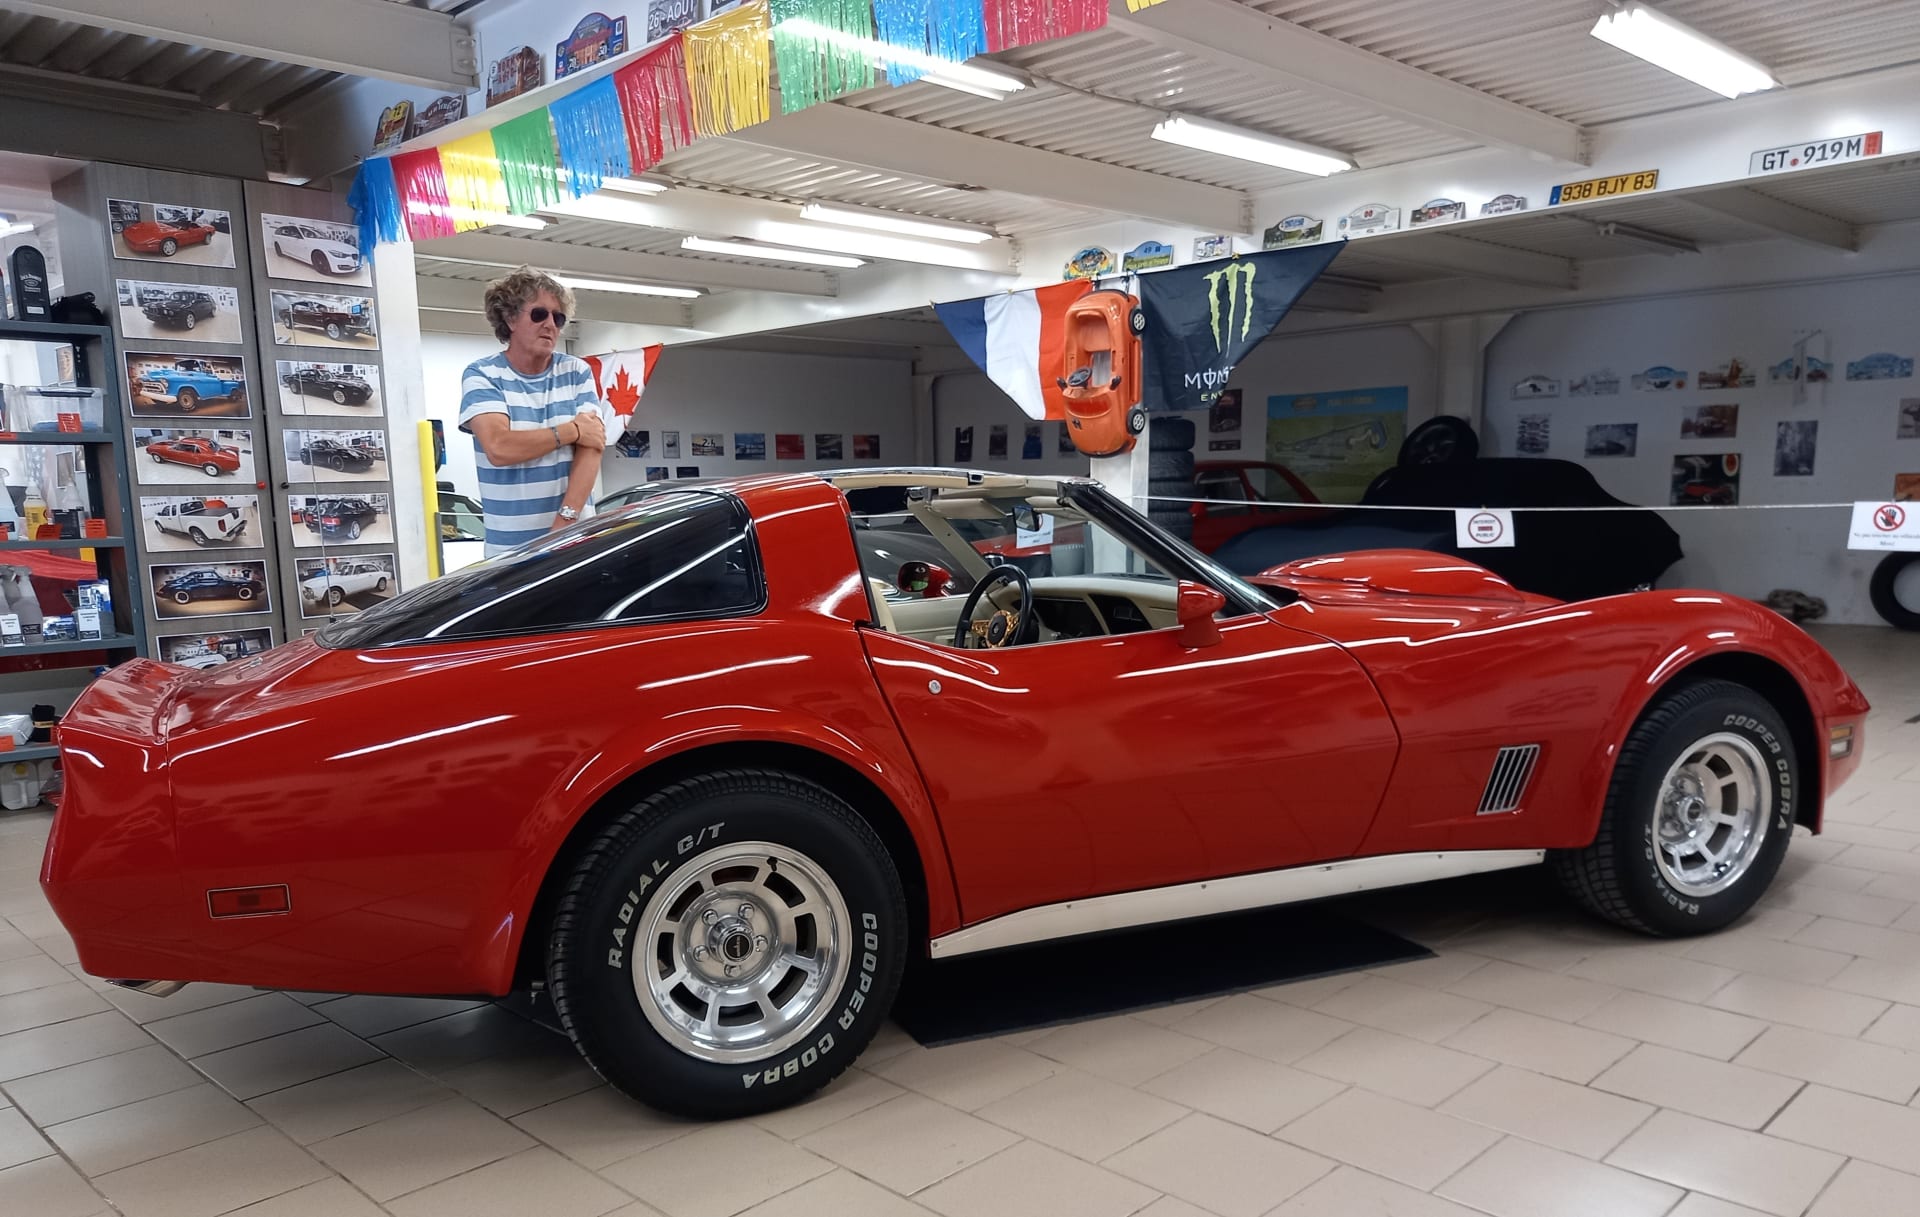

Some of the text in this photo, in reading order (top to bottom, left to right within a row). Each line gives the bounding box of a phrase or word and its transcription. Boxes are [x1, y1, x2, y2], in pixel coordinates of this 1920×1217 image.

[1562, 173, 1655, 202] 938 BJY 83
[1723, 714, 1791, 829] COOPER COBRA
[608, 822, 725, 968] RADIAL G/T
[742, 913, 878, 1088] COOPER COBRA
